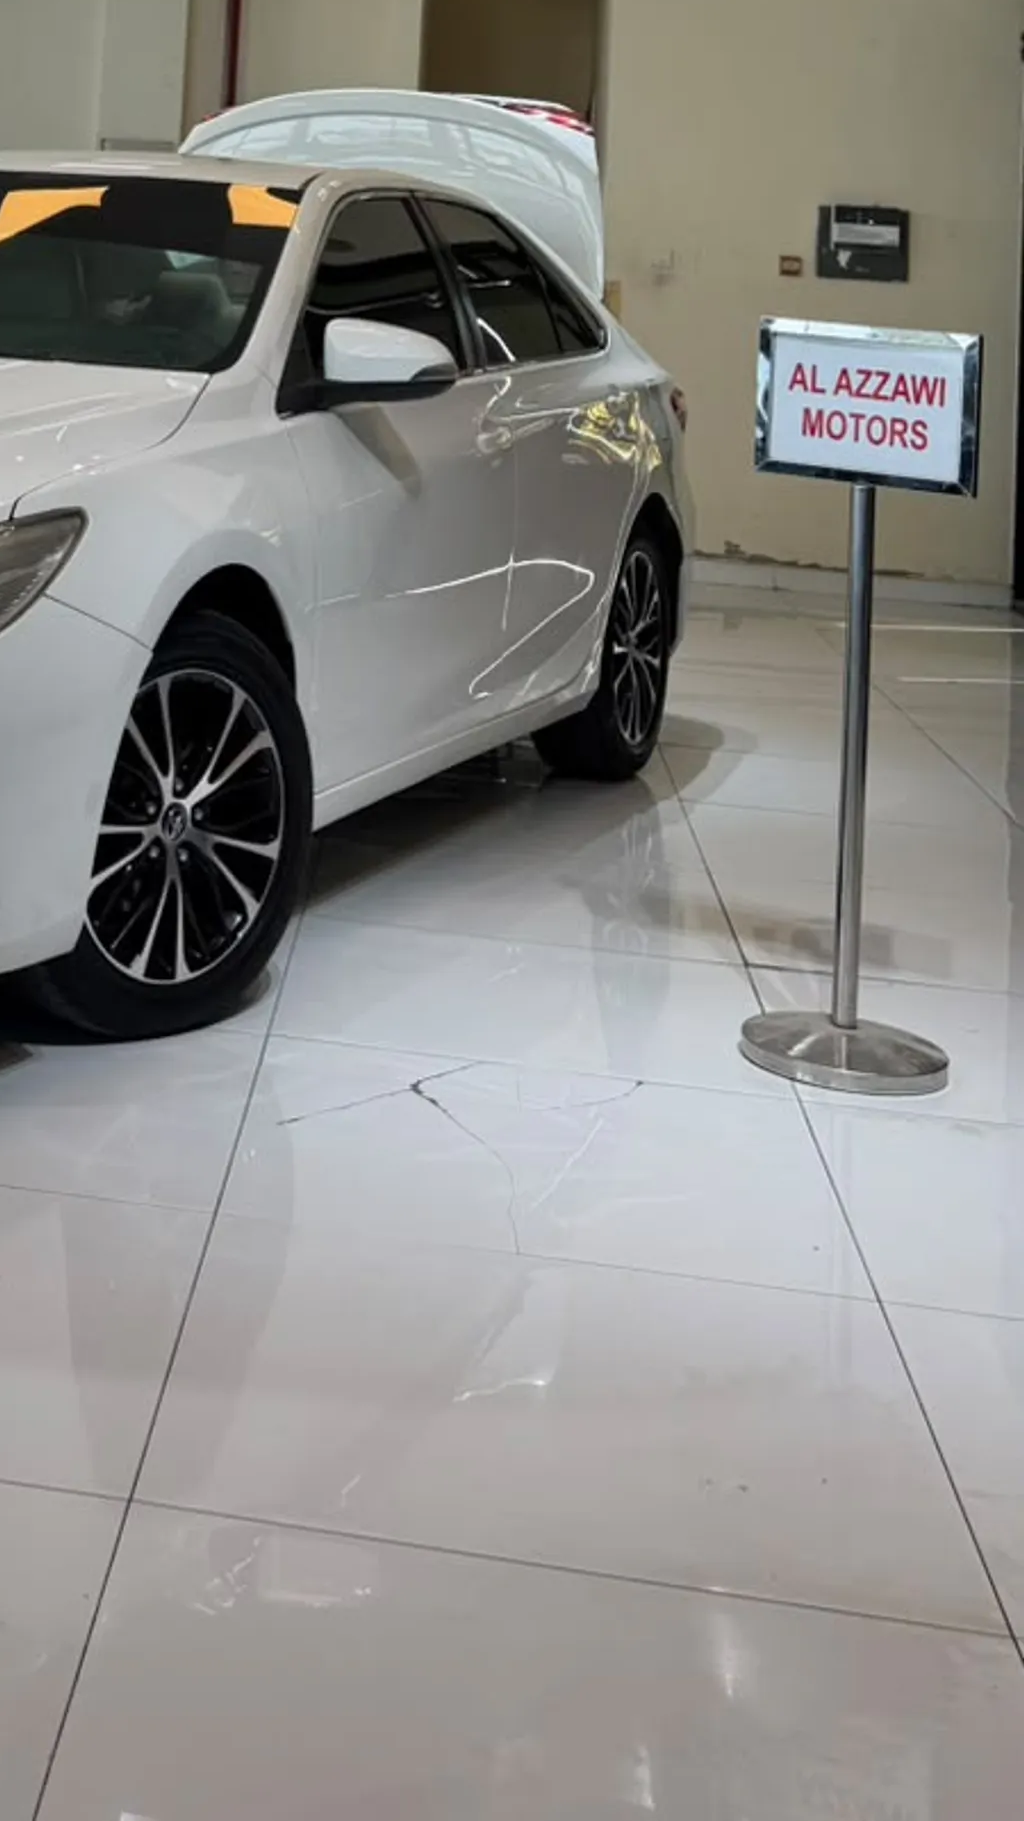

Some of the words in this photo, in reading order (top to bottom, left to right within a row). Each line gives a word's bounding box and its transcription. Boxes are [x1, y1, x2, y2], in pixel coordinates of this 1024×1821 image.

[788, 362, 826, 394] AL
[833, 367, 947, 408] AZZAWI
[801, 408, 929, 451] MOTORS
